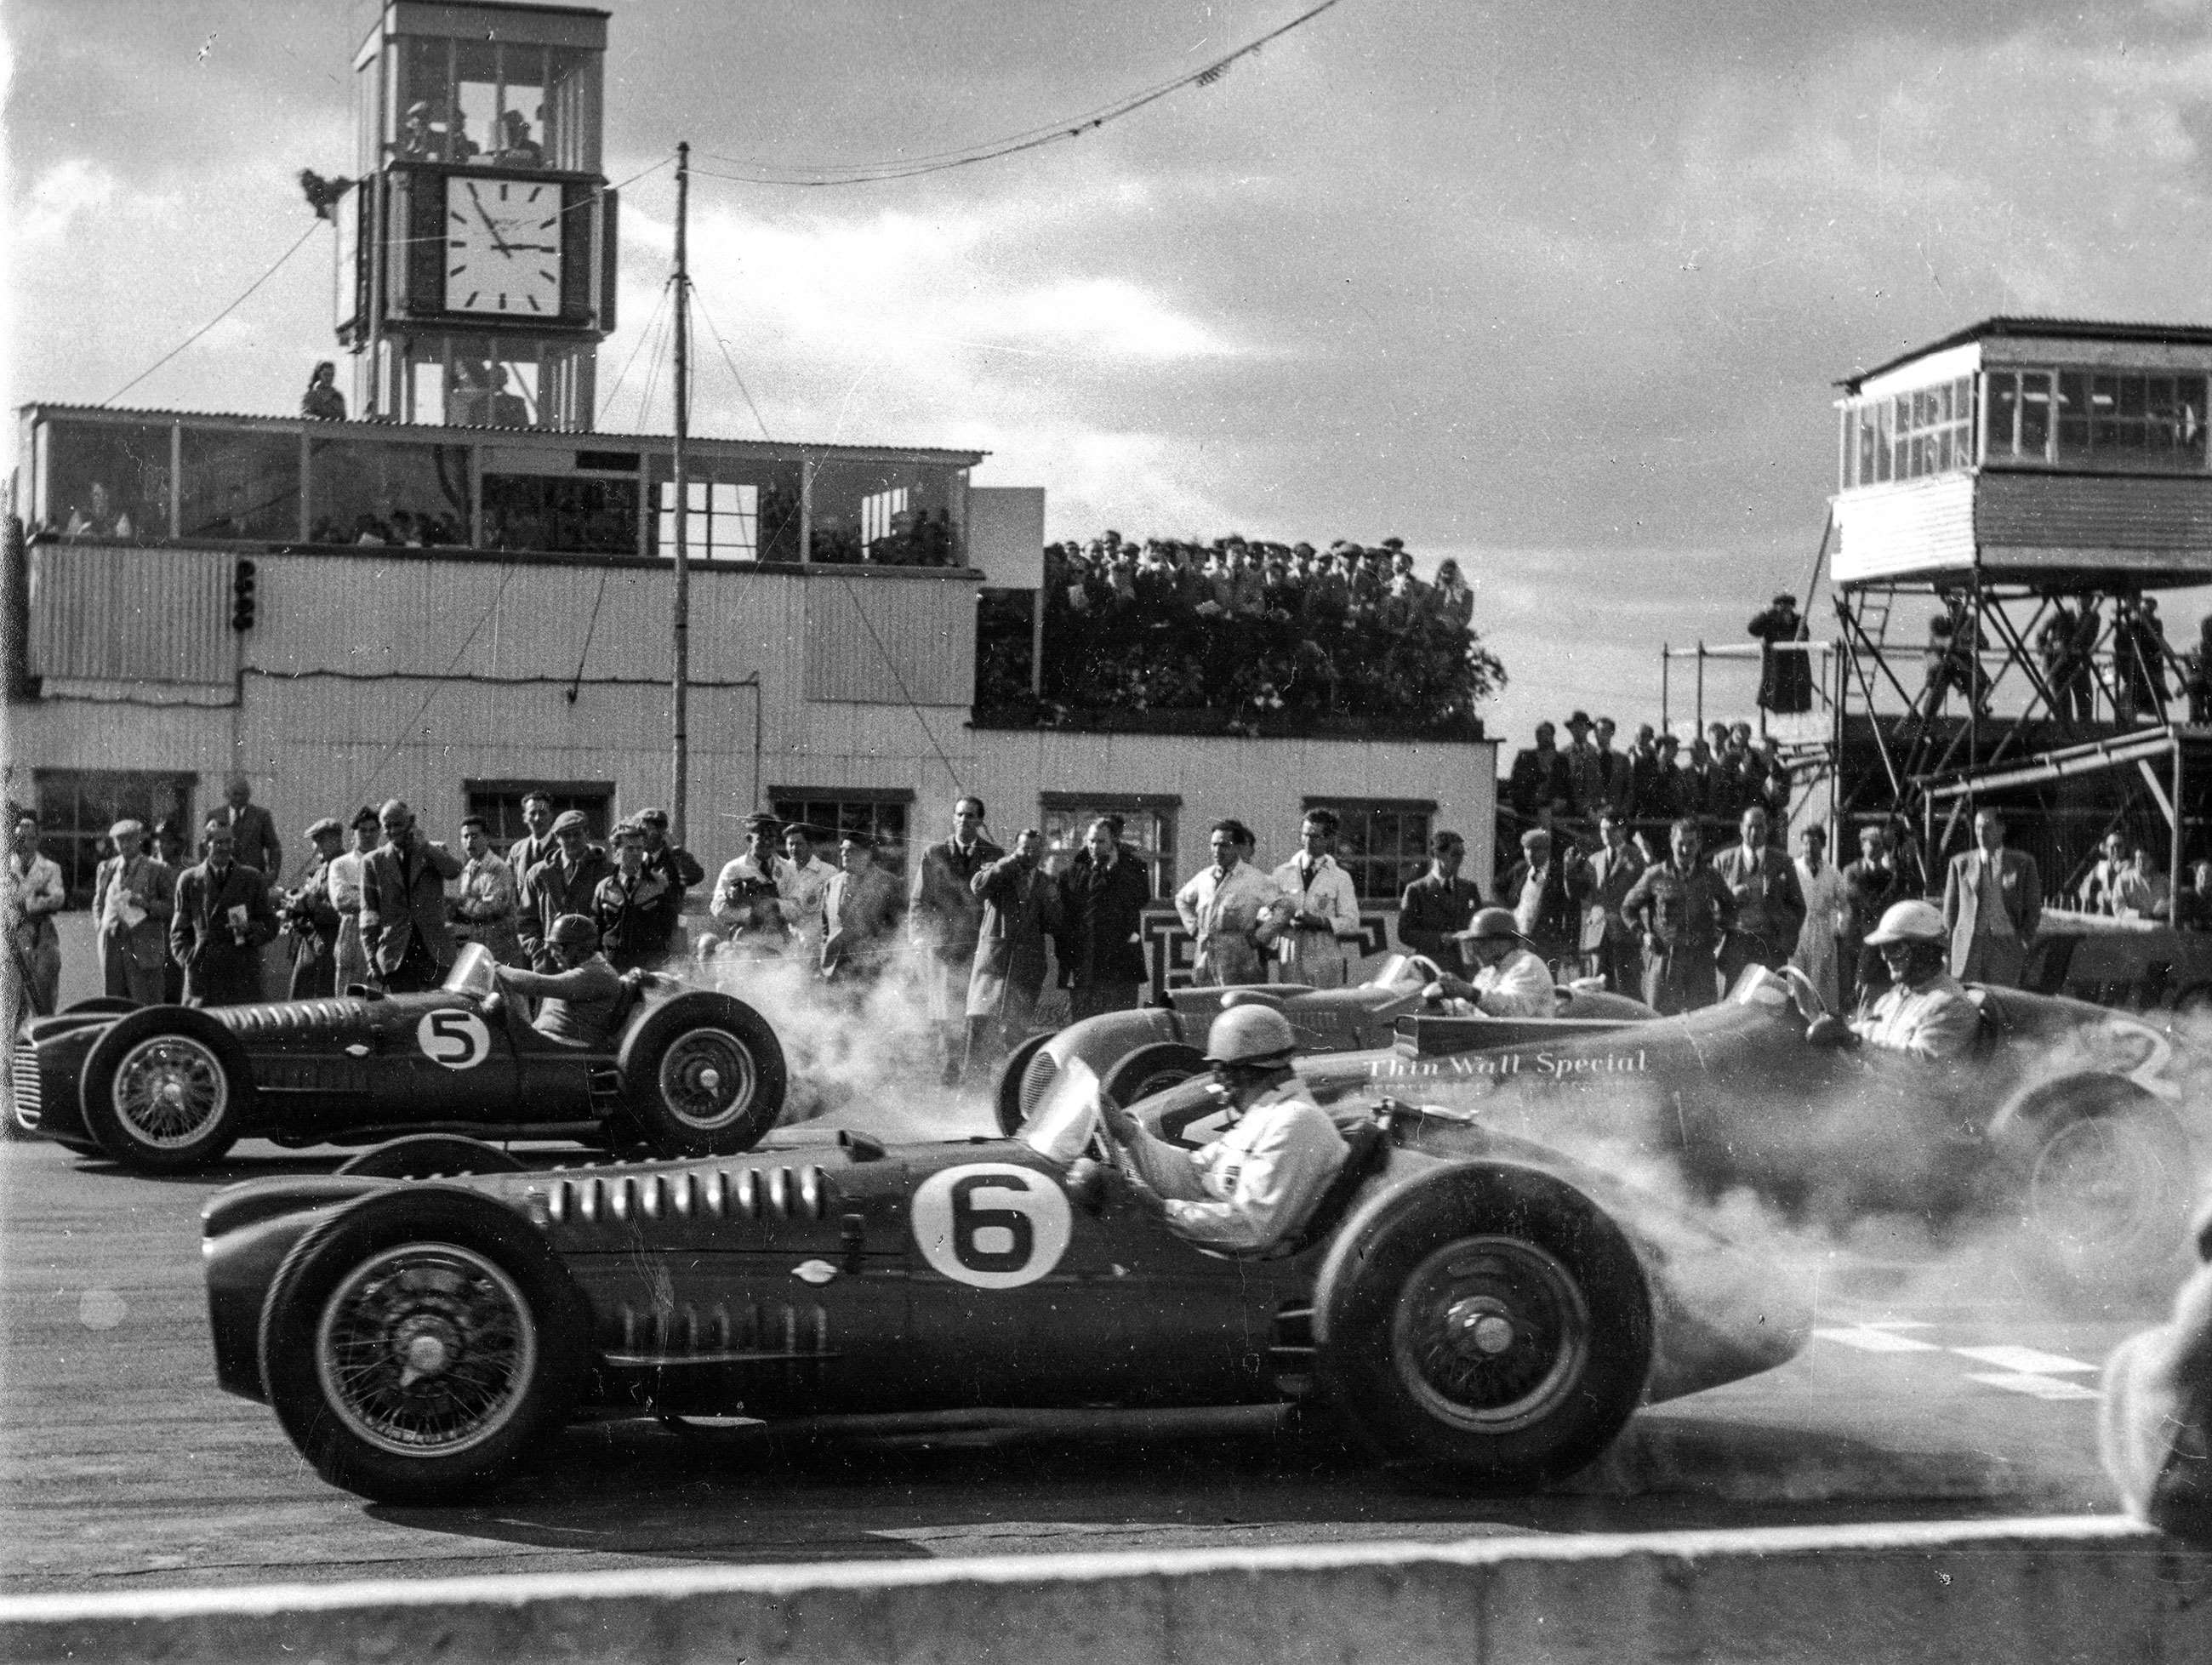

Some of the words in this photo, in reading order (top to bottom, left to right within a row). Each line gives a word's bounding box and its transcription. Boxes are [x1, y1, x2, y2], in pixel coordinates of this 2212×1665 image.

[430, 1013, 476, 1063] 5
[1364, 1056, 1439, 1077] Thin
[1449, 1053, 1519, 1075] Wall
[1536, 1049, 1646, 1079] Special
[951, 1174, 1035, 1273] 6
